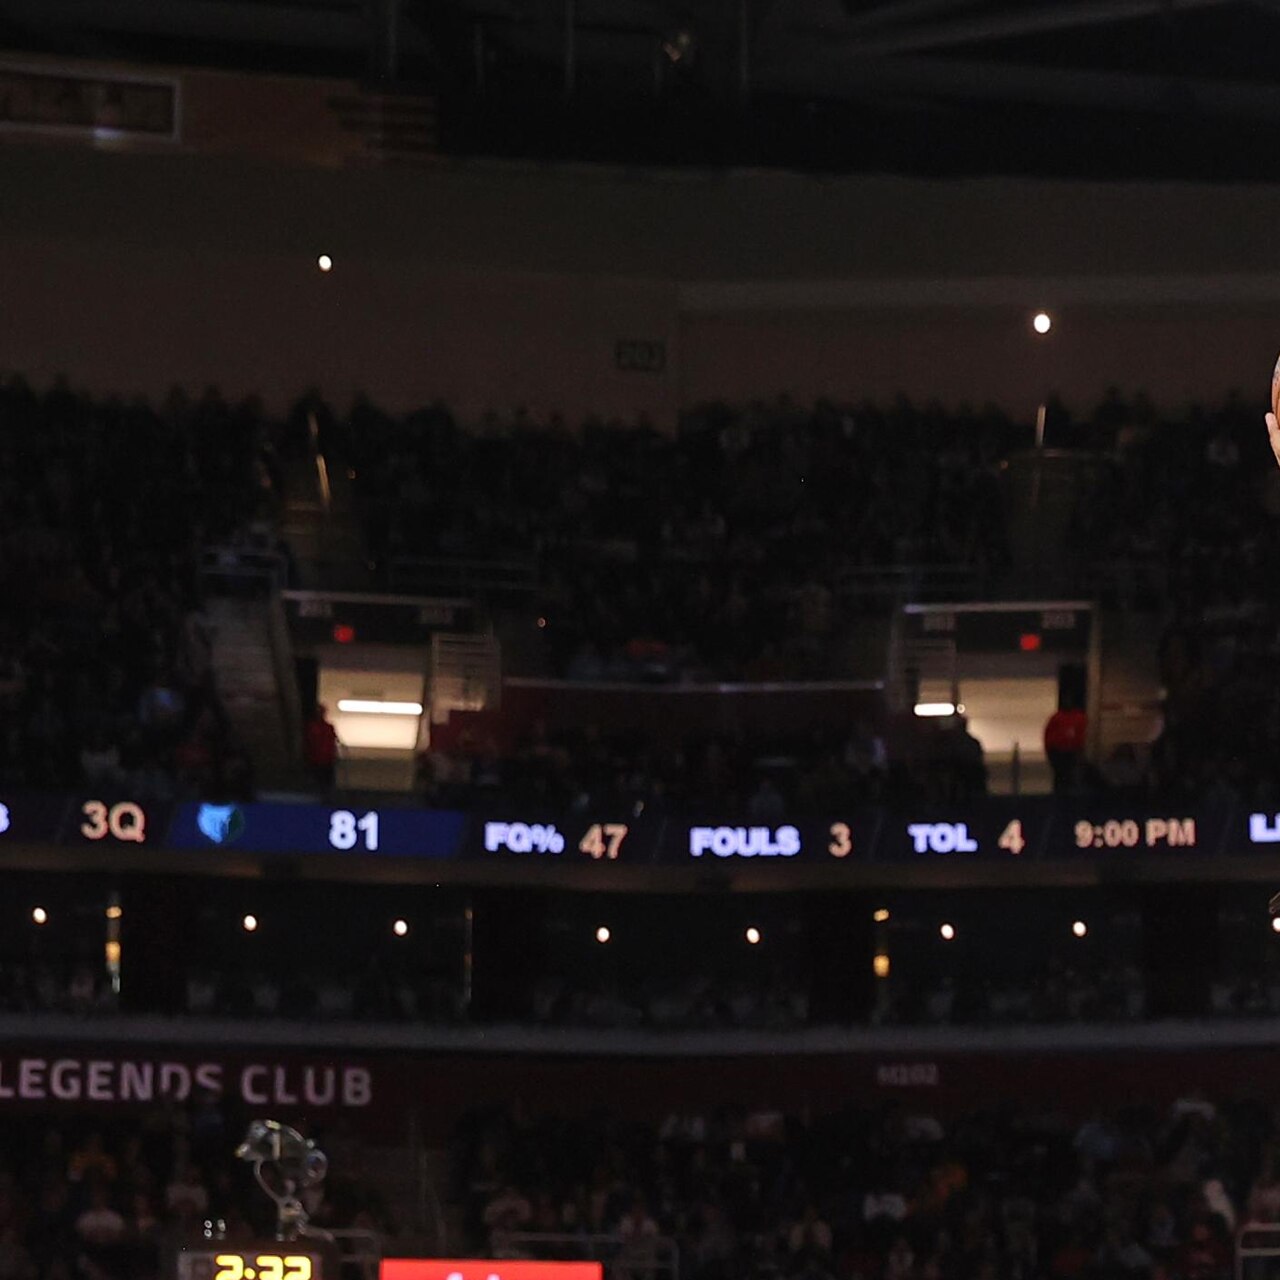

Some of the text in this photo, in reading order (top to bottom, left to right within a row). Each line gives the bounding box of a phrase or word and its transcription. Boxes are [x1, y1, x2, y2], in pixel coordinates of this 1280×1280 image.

[81, 800, 146, 842] 3Q
[328, 808, 379, 851] 81
[579, 822, 628, 860] 47
[690, 825, 801, 857] FOULS
[829, 822, 851, 859] 3
[908, 822, 978, 854] TOL
[999, 819, 1025, 855] 4
[1074, 818, 1139, 849] 9:00
[1145, 817, 1196, 848] PM
[240, 1064, 372, 1107] CLUB
